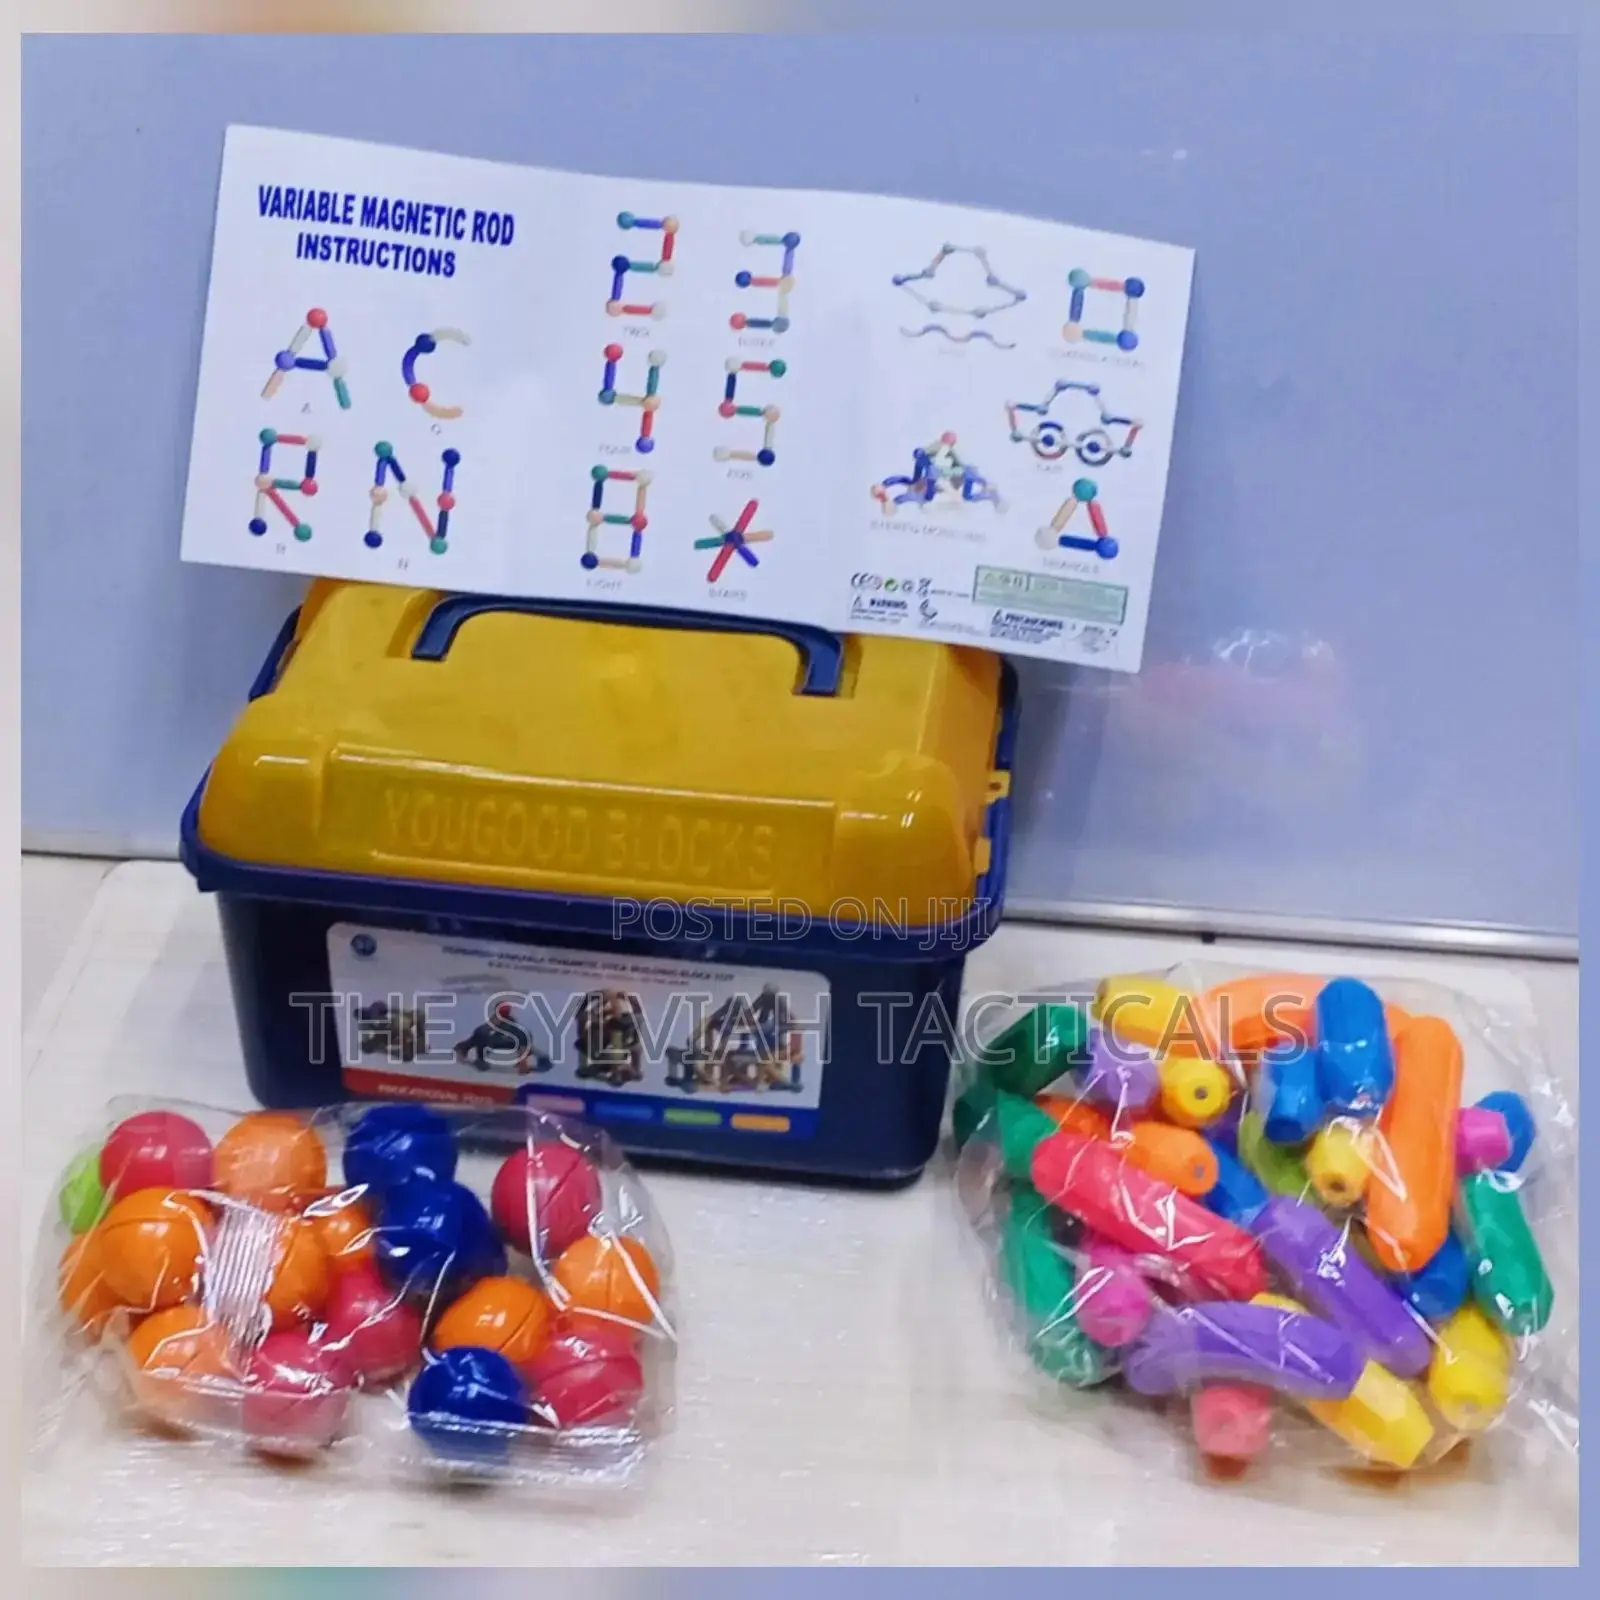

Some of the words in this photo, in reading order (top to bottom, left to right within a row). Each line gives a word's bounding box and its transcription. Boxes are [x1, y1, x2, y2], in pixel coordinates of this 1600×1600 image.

[258, 184, 356, 226] VARIABLE
[360, 195, 467, 241] MAGNETIC
[471, 210, 515, 247] ROD
[296, 232, 456, 279] INSTRUCTIONS
[384, 786, 591, 867] YOUGOOD
[603, 807, 776, 883] BLOCKS
